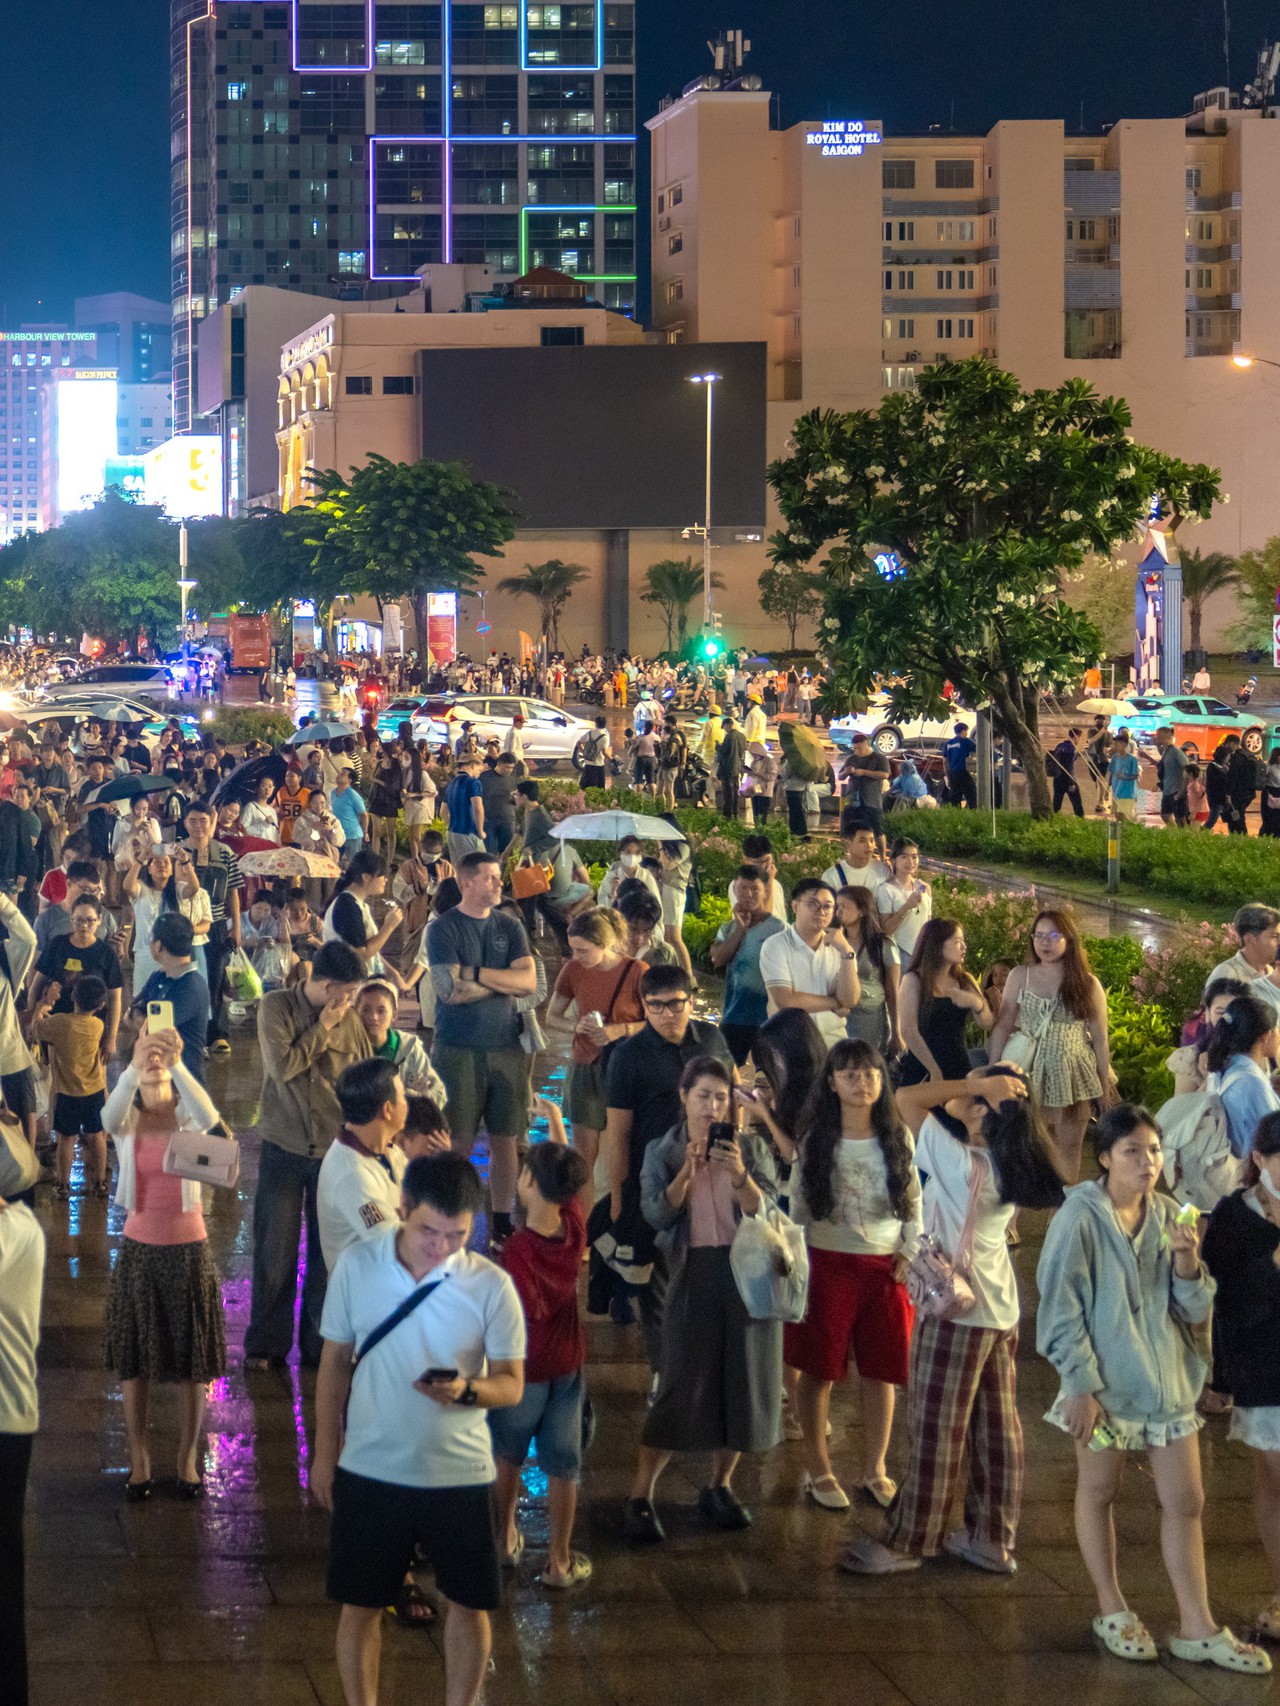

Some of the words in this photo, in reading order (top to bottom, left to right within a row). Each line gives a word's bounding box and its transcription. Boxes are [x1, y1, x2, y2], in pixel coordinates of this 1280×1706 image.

[823, 122, 845, 132] KIM
[847, 122, 863, 132] DO
[806, 134, 843, 144] ROYAL
[844, 133, 881, 143] HOTEL
[822, 145, 862, 155] SAIGON
[4, 333, 42, 341] HARBOUR
[44, 333, 64, 341] VIEW
[66, 333, 96, 341] TOWER
[282, 803, 302, 817] 58
